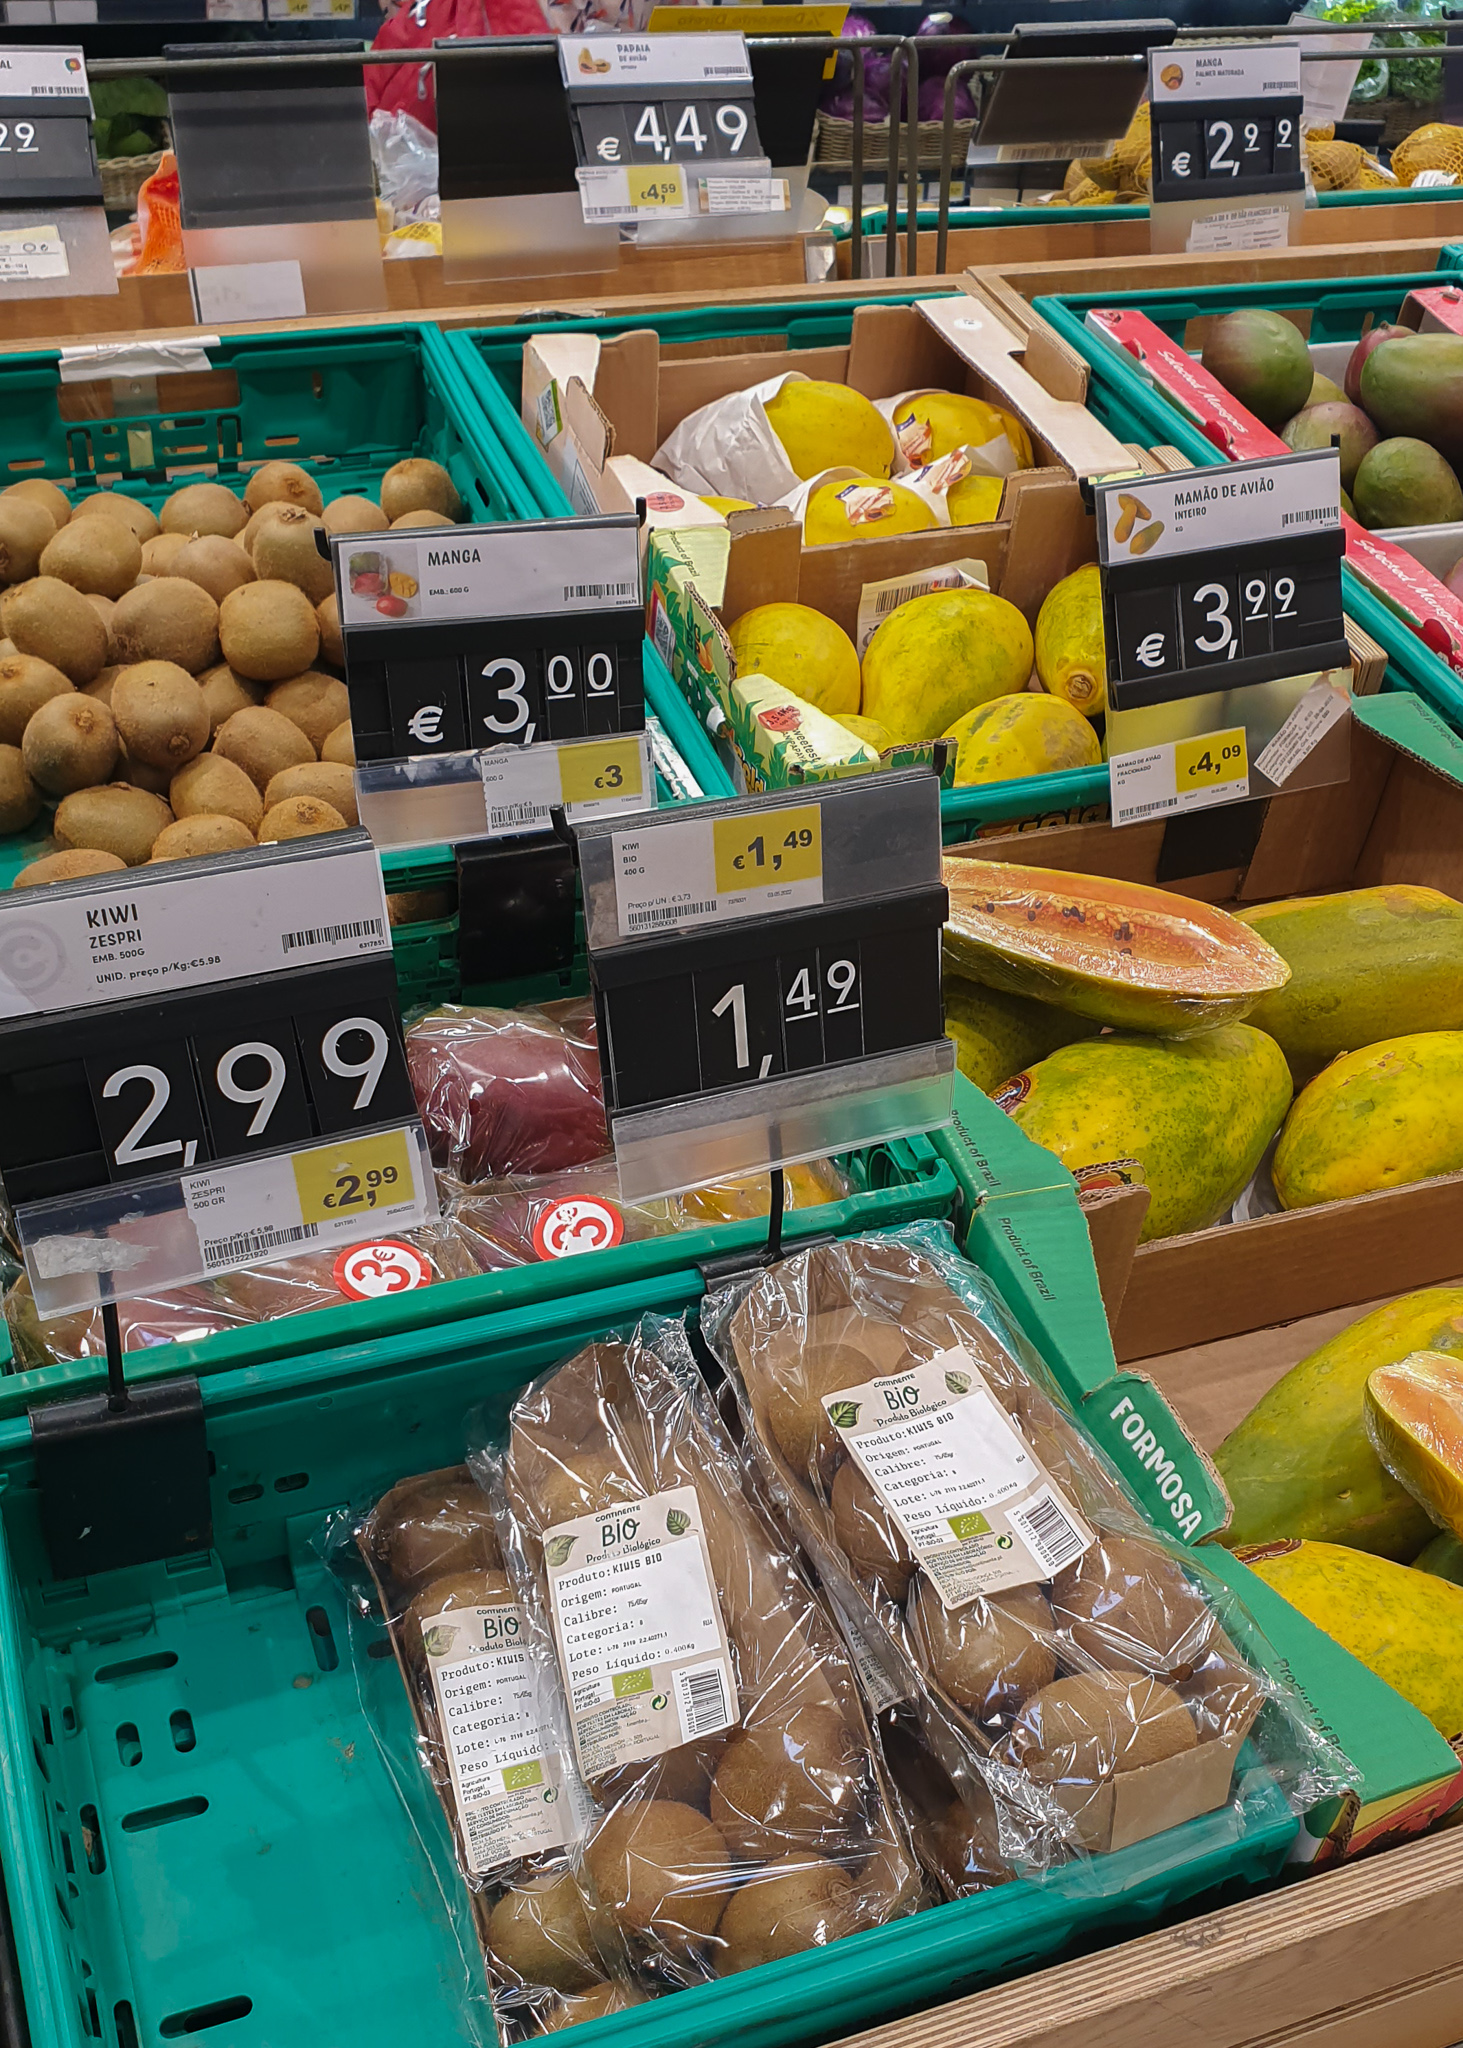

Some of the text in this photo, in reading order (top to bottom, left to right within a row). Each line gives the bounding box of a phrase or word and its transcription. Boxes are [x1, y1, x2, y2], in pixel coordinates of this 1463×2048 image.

[617, 44, 651, 54] PAPAIA
[1196, 58, 1223, 67] MANGA
[596, 104, 748, 162] € 4,49
[1171, 119, 1292, 176] € 2,99
[641, 183, 677, 205] €4,59
[1157, 350, 1206, 397] Selected
[1174, 477, 1275, 507] MAMÃO DE AVIÃO
[1174, 506, 1207, 521] INTEIRO
[427, 548, 481, 566] MANGA
[1353, 539, 1417, 582] Selected
[449, 587, 461, 595] 600
[1136, 577, 1297, 668] € 3,99
[408, 652, 615, 744] € 3,00
[484, 757, 509, 767] MANGA
[1117, 765, 1151, 777] FRACIONADO
[1188, 745, 1241, 776] €4,09
[594, 765, 623, 789] €3
[622, 843, 640, 851] KIWI
[733, 828, 813, 871] €1,49
[623, 855, 637, 864] BIO
[624, 866, 645, 876] 400 G
[628, 901, 647, 910] Preço
[656, 897, 667, 906] UN
[677, 893, 691, 902] 3,73
[86, 903, 139, 929] KIWI
[89, 929, 143, 950] ZESPRI
[92, 948, 146, 964] EMB. 500G
[96, 955, 221, 984] UNID. preço p/Kg:€5.98
[711, 960, 860, 1079] 1,49
[103, 1017, 390, 1168] 2,99
[970, 1143, 984, 1158] of
[976, 1156, 1002, 1187] Brazil
[190, 1179, 211, 1190] KIWI
[191, 1186, 226, 1200] ZESPRI
[323, 1166, 398, 1208] €2,99
[193, 1196, 226, 1210] 500 GR
[204, 1225, 274, 1246] Preço 5,98
[206, 1249, 269, 1269] 5601312221920
[999, 1216, 1056, 1302] Product of Brazil
[876, 1399, 947, 1427] Produto Biológico
[856, 1411, 955, 1449] Produto: KIWIS BIO
[865, 1439, 942, 1463] Origem: PORTUGAL
[874, 1458, 926, 1477] Calibre:
[1109, 1396, 1202, 1540] FORMOSA
[884, 1469, 949, 1492] Categoria:
[893, 1492, 927, 1507] Lote:
[902, 1508, 931, 1523] Peso
[935, 1496, 988, 1516] Líquido:
[910, 1524, 939, 1536] Agricultura
[623, 1538, 661, 1556] Biológico
[558, 1552, 663, 1591] Produto: KIWIS BIO
[561, 1582, 642, 1608] Origem: PORTUGAL
[564, 1604, 618, 1627] Calibre:
[566, 1620, 635, 1645] Categoria:
[469, 1642, 504, 1654] oduto
[569, 1646, 603, 1663] Lote:
[441, 1653, 525, 1682] Produto: KIWIS
[572, 1642, 695, 1682] Peso Líquido: 0.400Kg
[444, 1674, 527, 1699] Origem: PORTUGAL
[573, 1682, 601, 1696] Agricultura
[574, 1692, 596, 1704] Portugal
[449, 1695, 503, 1718] Calibre:
[452, 1712, 520, 1736] Categoria:
[456, 1739, 490, 1756] Lote:
[460, 1742, 549, 1775] Peso Líquido:
[461, 1776, 491, 1789] Agricultura
[463, 1784, 486, 1795] Portugal
[464, 1790, 491, 1803] PT-BIO-03
